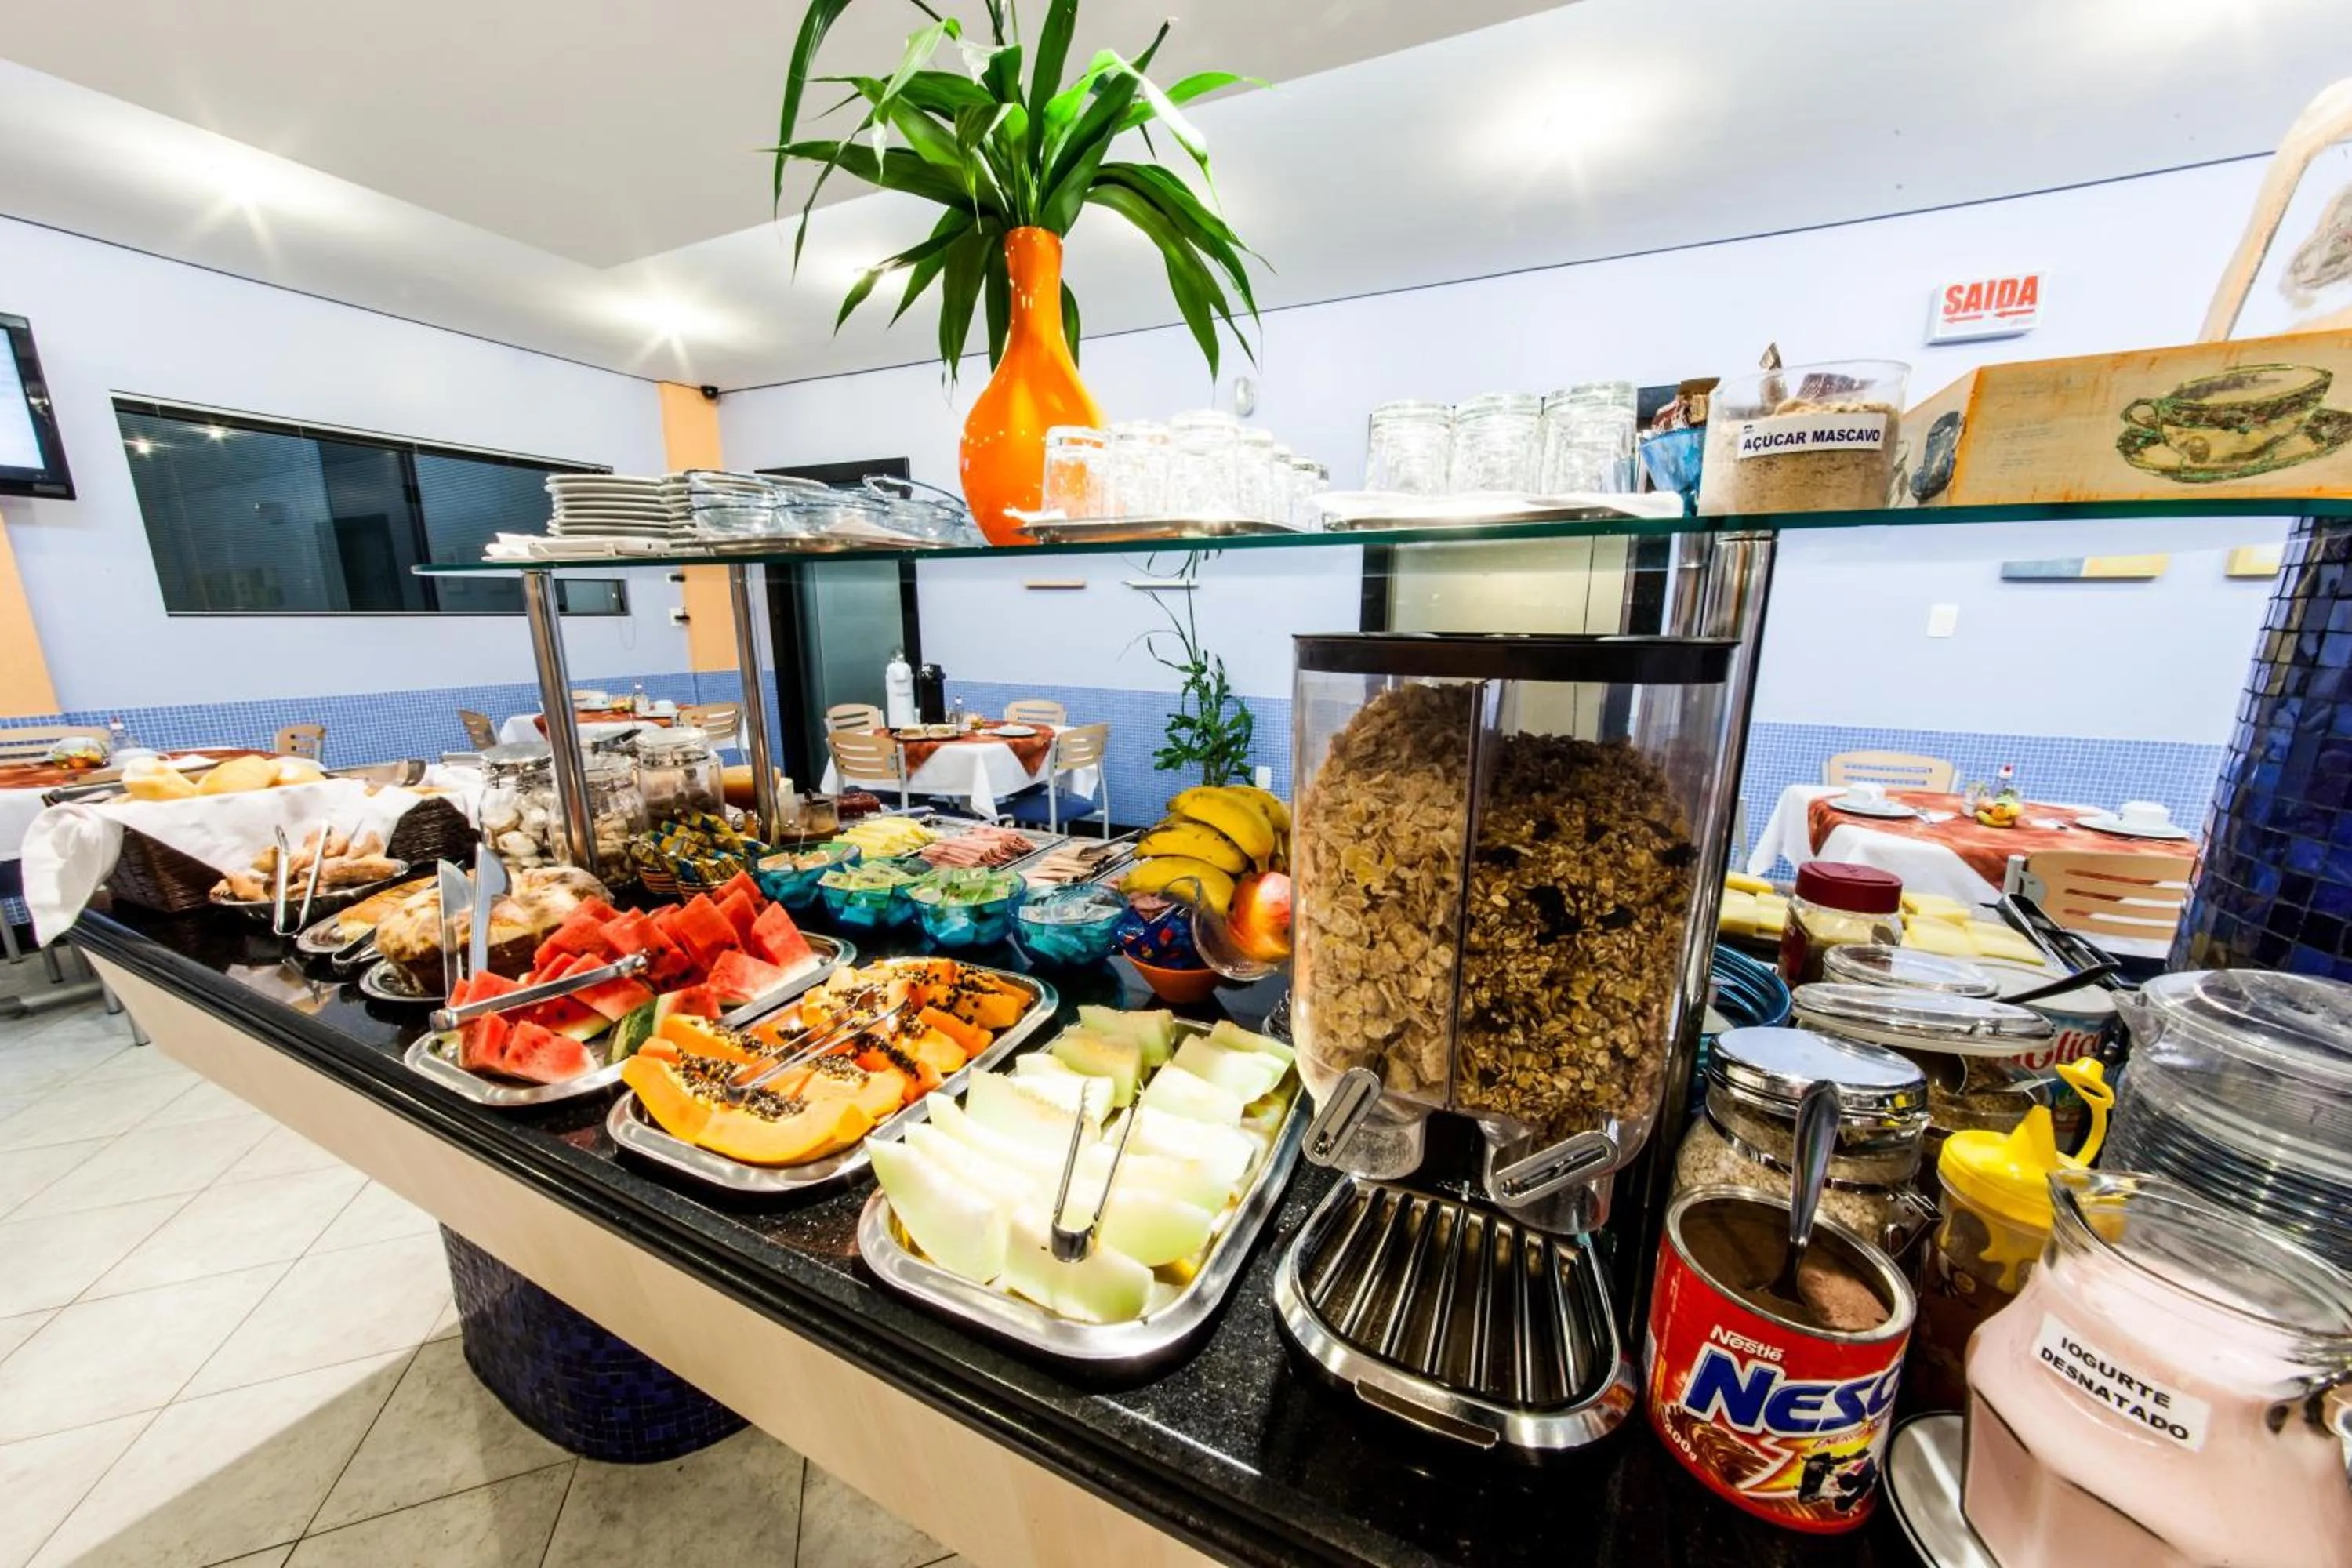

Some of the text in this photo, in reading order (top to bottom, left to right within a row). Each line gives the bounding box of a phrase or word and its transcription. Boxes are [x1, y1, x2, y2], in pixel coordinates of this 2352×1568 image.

[1943, 274, 2039, 316] SAIDA
[1743, 428, 1881, 452] AÇÚCAR MASCAVO
[2040, 1346, 2190, 1441] DESNATADO
[2061, 1337, 2171, 1409] IOGURTE
